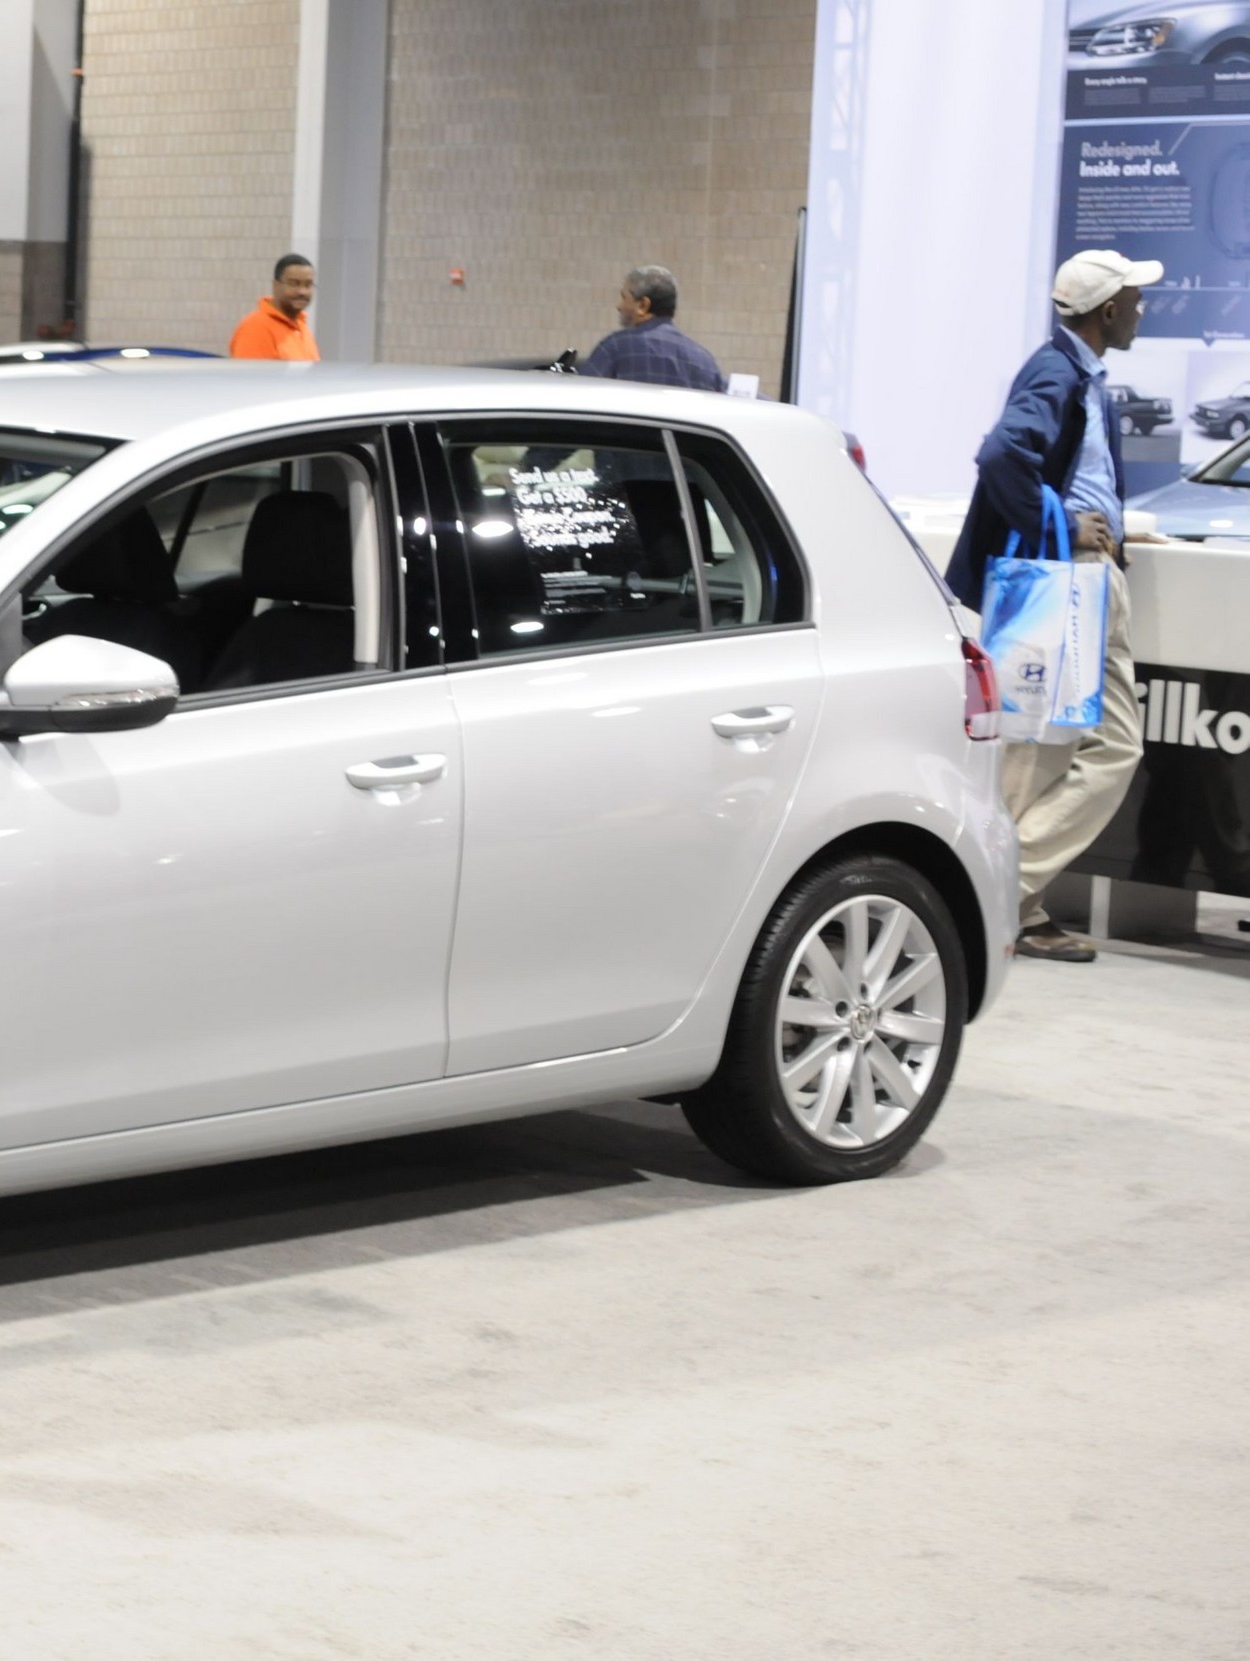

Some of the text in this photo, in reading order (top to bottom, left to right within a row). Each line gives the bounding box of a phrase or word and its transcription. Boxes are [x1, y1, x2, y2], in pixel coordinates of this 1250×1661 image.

[1081, 140, 1163, 161] Redesigned.
[1079, 159, 1180, 177] Inside and out.
[509, 465, 544, 485] Send
